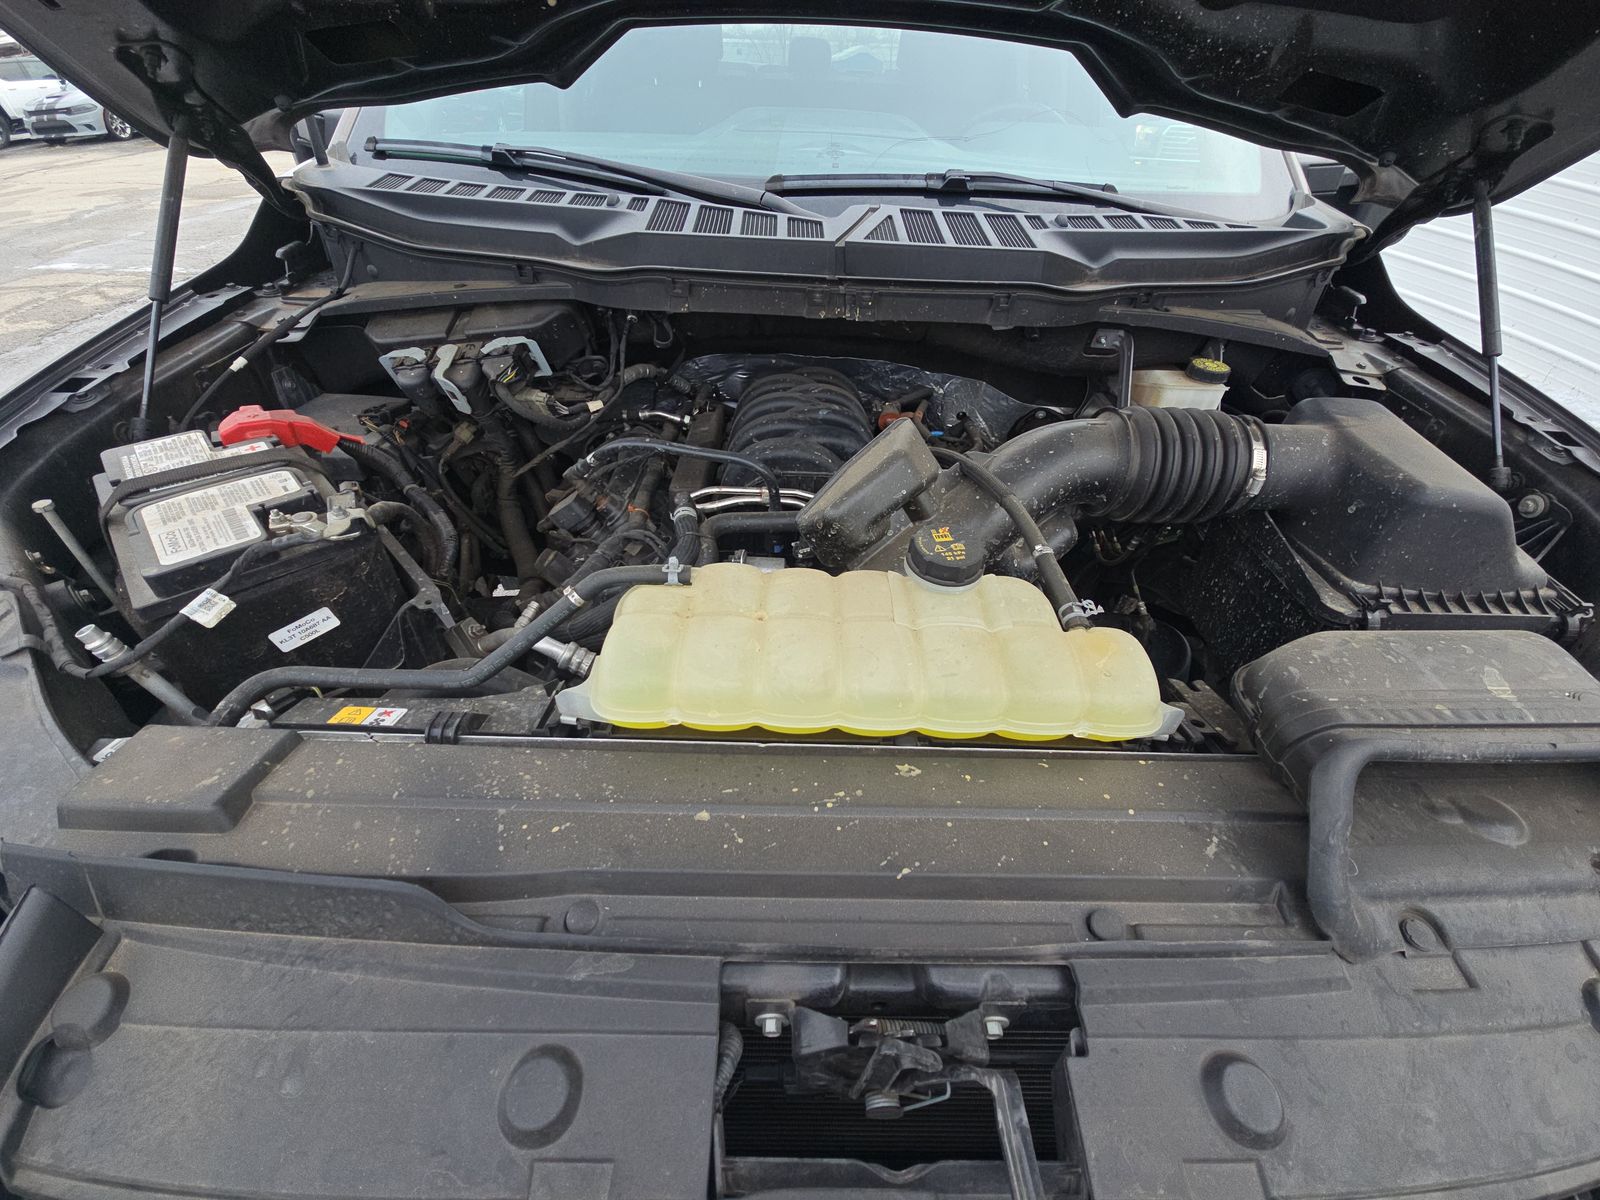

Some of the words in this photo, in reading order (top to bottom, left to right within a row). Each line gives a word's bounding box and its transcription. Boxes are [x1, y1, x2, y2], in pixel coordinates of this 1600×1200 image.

[279, 633, 297, 644] KL3T
[321, 616, 332, 624] AA
[287, 618, 315, 633] FoMoCo
[300, 629, 320, 641] C500L
